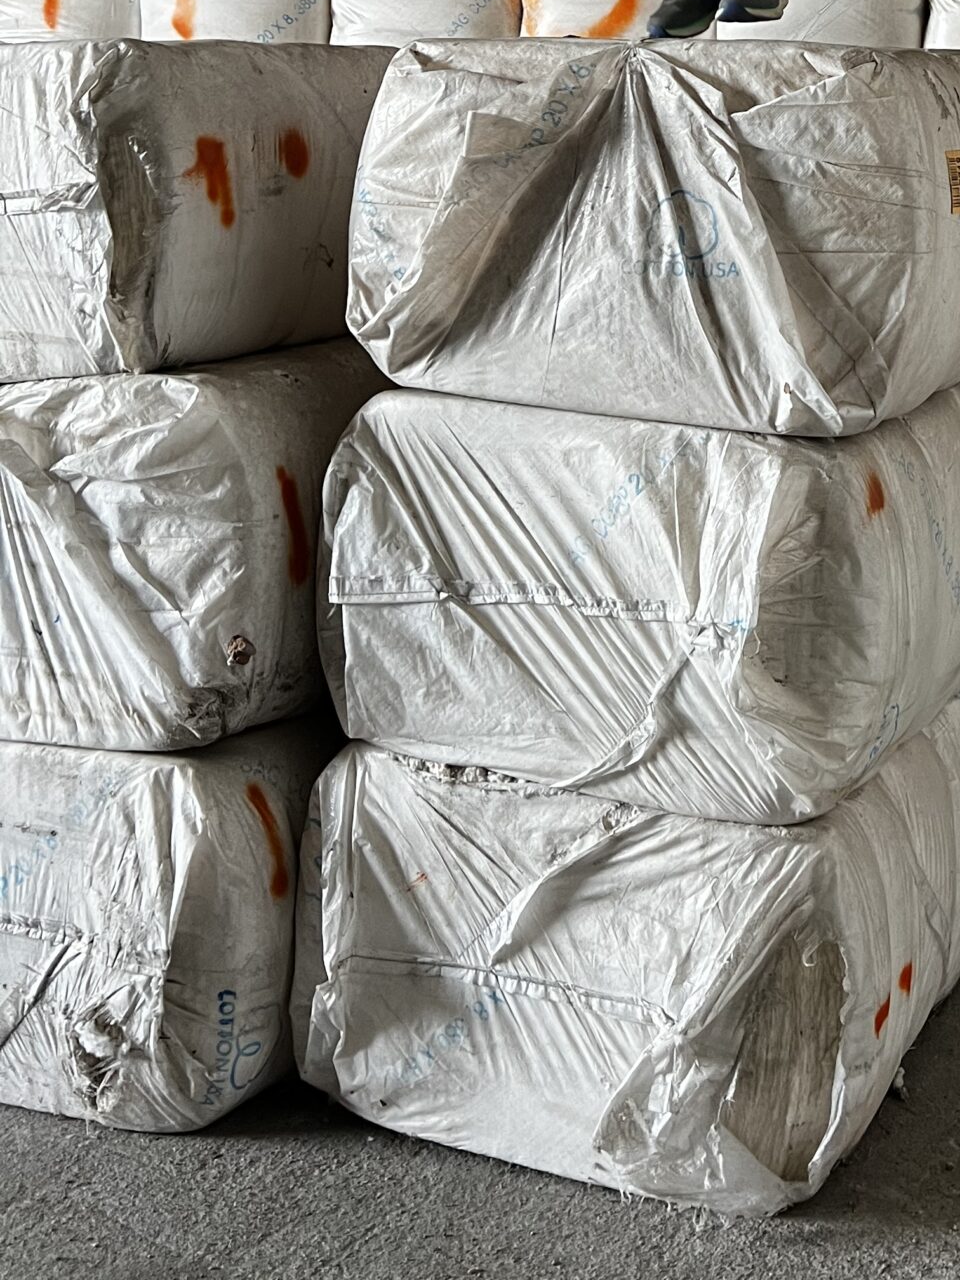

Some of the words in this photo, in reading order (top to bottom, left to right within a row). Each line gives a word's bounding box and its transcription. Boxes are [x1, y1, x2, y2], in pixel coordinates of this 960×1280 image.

[257, 28, 272, 45] 20
[270, 21, 284, 33] X
[541, 99, 569, 127] 20
[558, 76, 581, 97] X
[702, 261, 740, 279] USA
[217, 988, 237, 1073] COTTON
